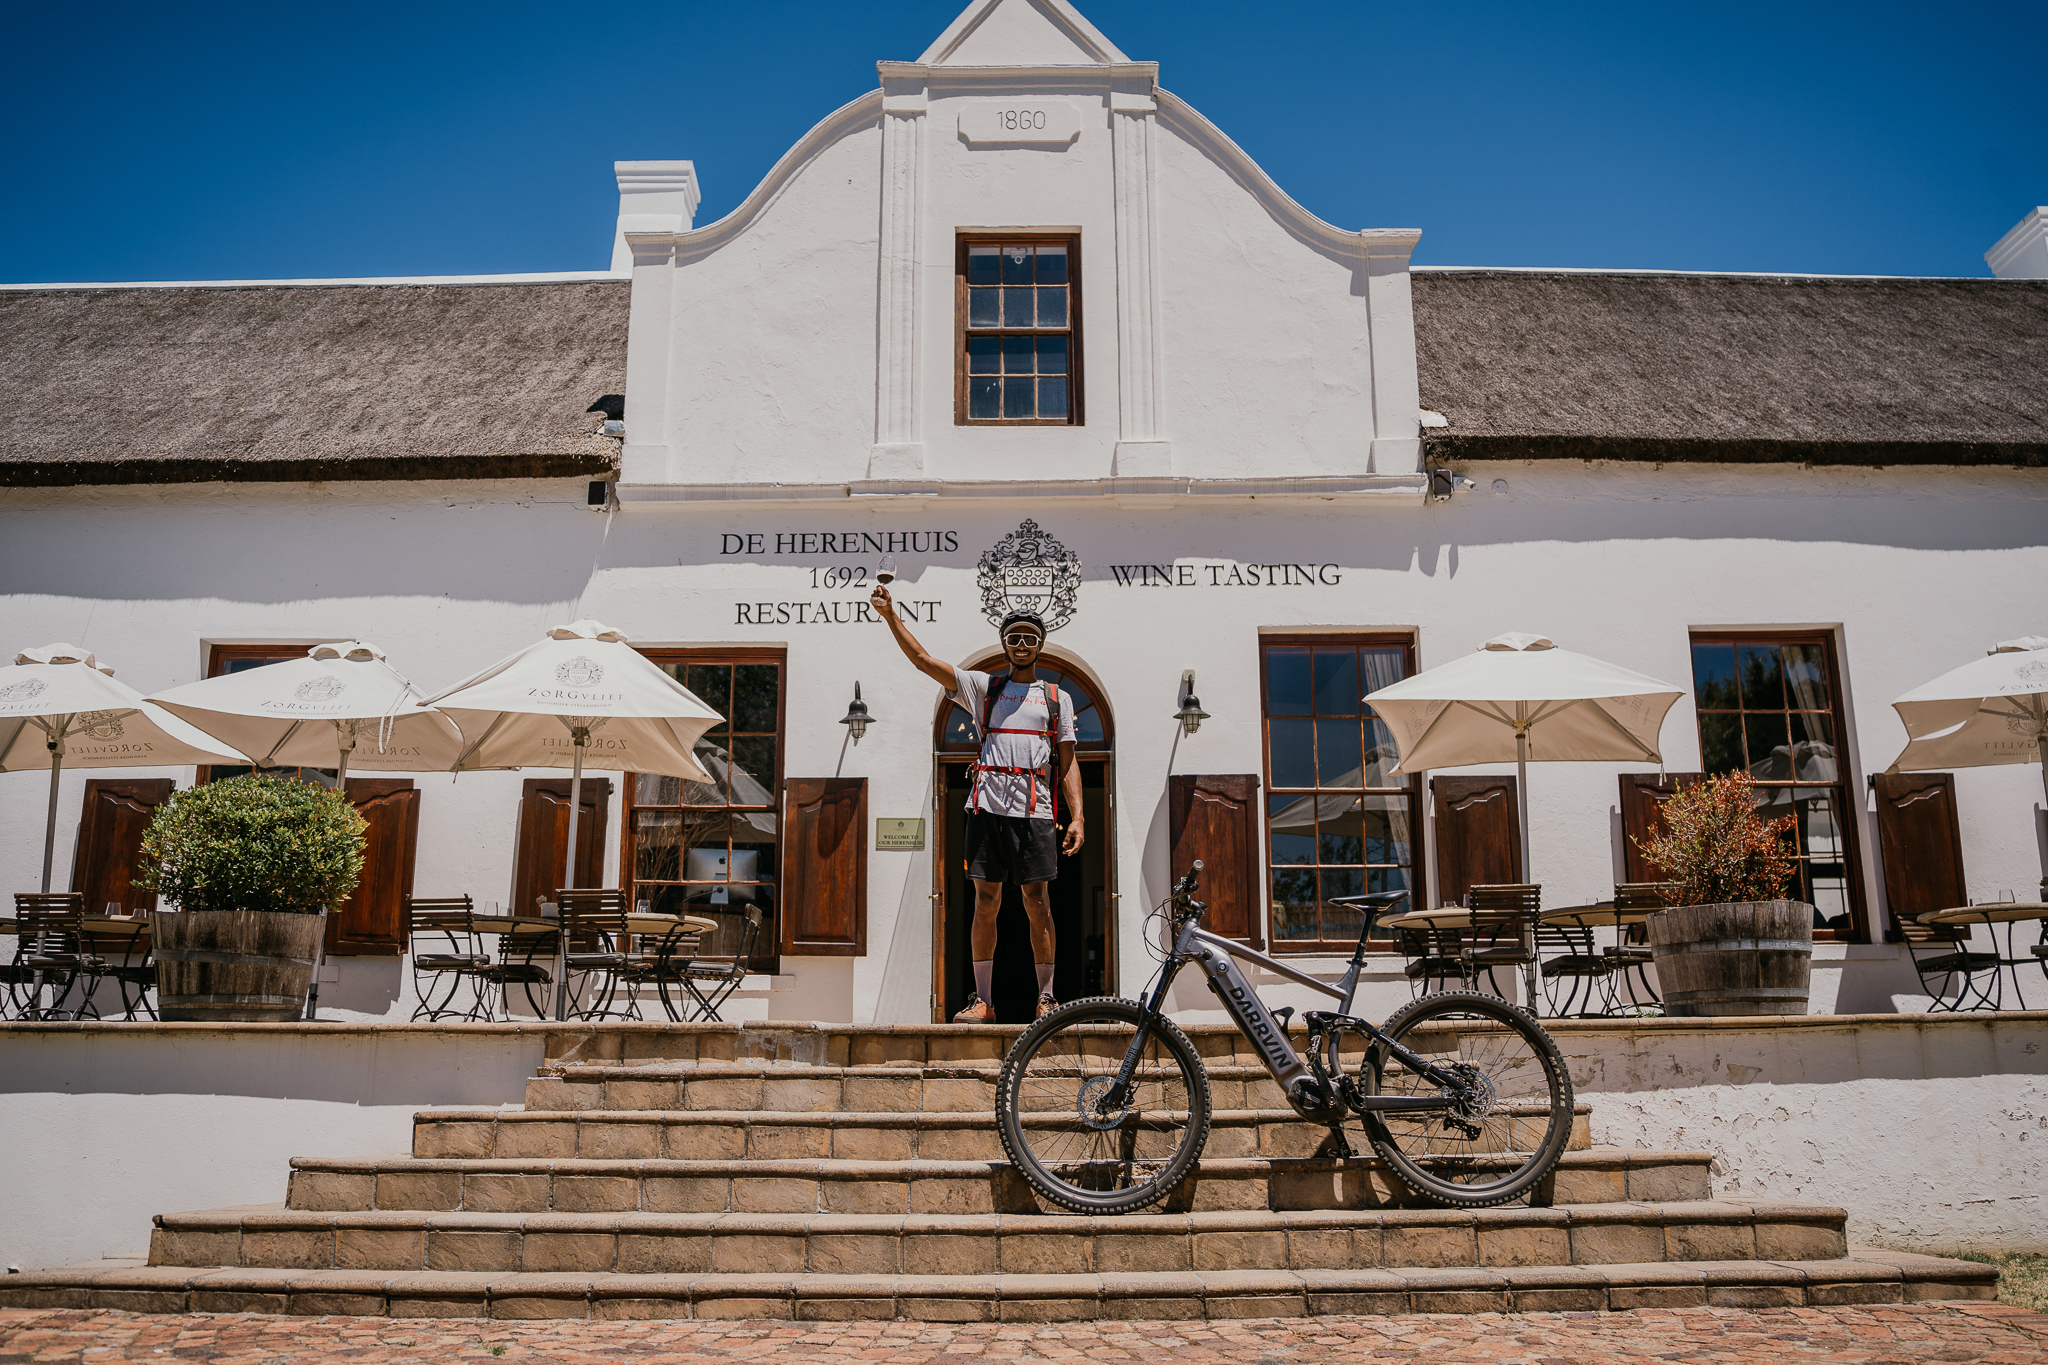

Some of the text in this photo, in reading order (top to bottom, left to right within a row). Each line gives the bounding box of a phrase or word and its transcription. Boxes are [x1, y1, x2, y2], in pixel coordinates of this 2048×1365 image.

[997, 110, 1046, 130] 1860
[719, 531, 959, 555] DE HERENHUIS
[809, 566, 868, 589] 1692
[1110, 563, 1343, 588] WINE TASTING
[734, 600, 942, 625] RESTAURNT
[260, 700, 353, 711] ZORGVLIET
[528, 688, 624, 701] ZORGVLIET
[1000, 693, 1017, 702] Best
[1034, 697, 1047, 705] Eve
[1228, 986, 1293, 1069] DARRVIN
[1115, 1047, 1139, 1085] ROCKSHOX
[1005, 1060, 1020, 1113] MAXXIS
